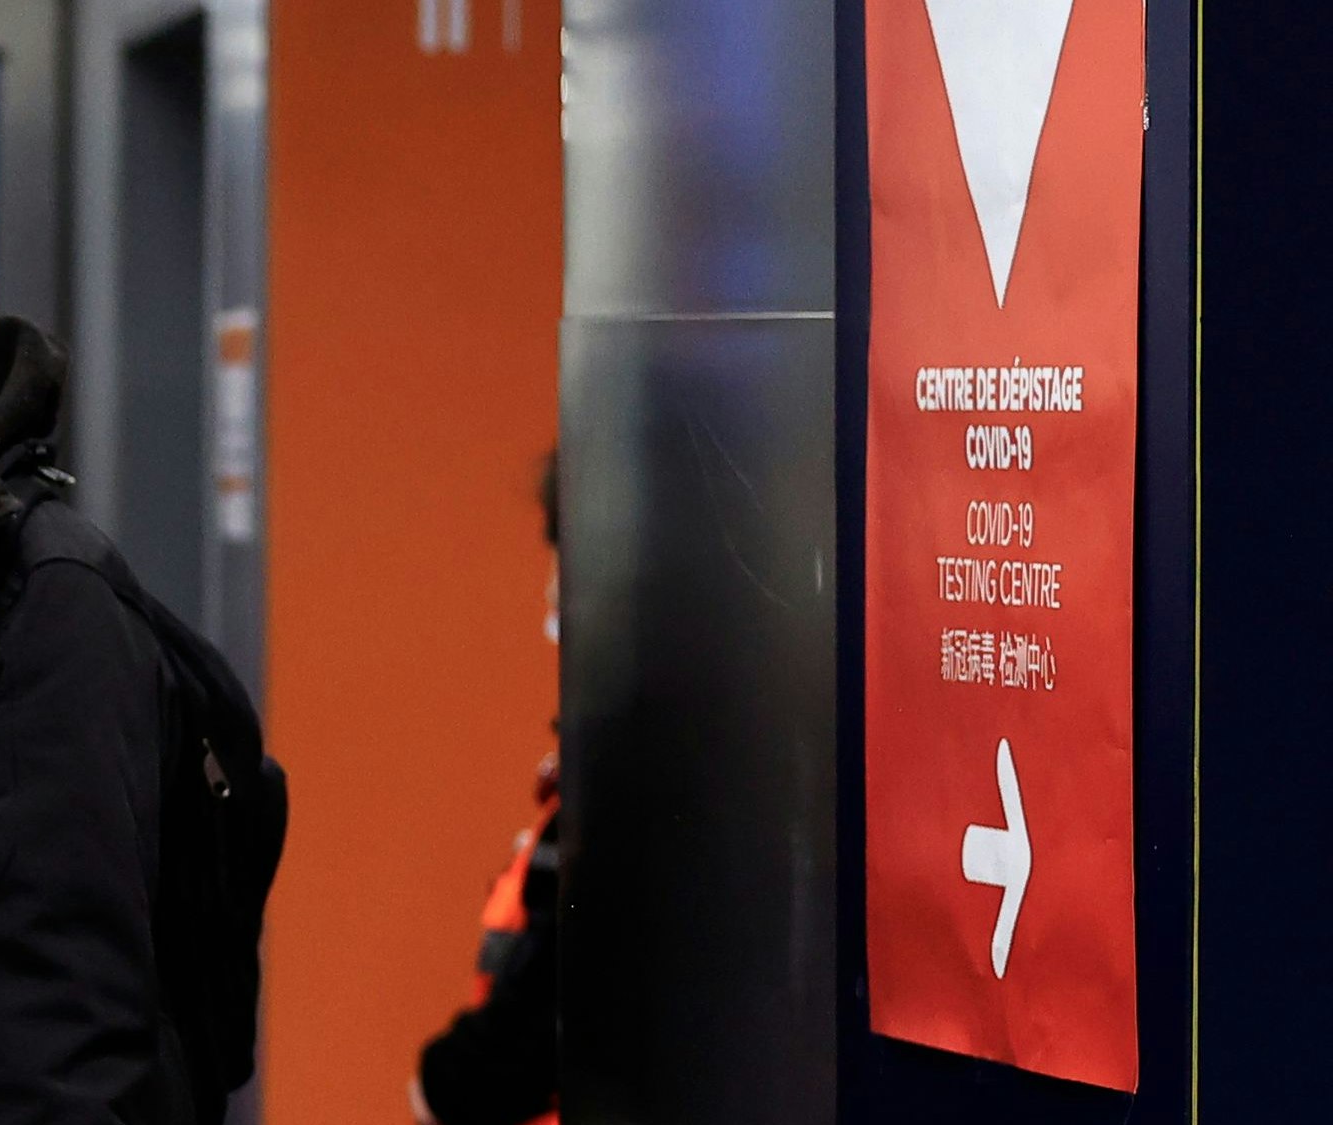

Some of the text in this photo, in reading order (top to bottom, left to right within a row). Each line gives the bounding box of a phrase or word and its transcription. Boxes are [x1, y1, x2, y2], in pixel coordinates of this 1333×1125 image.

[916, 355, 1083, 412] CENTRE DE DÉPISTAGE
[966, 424, 1032, 470] COVID-19
[966, 500, 1033, 548] COVID-19
[936, 556, 1062, 608] TESTING CENTRE
